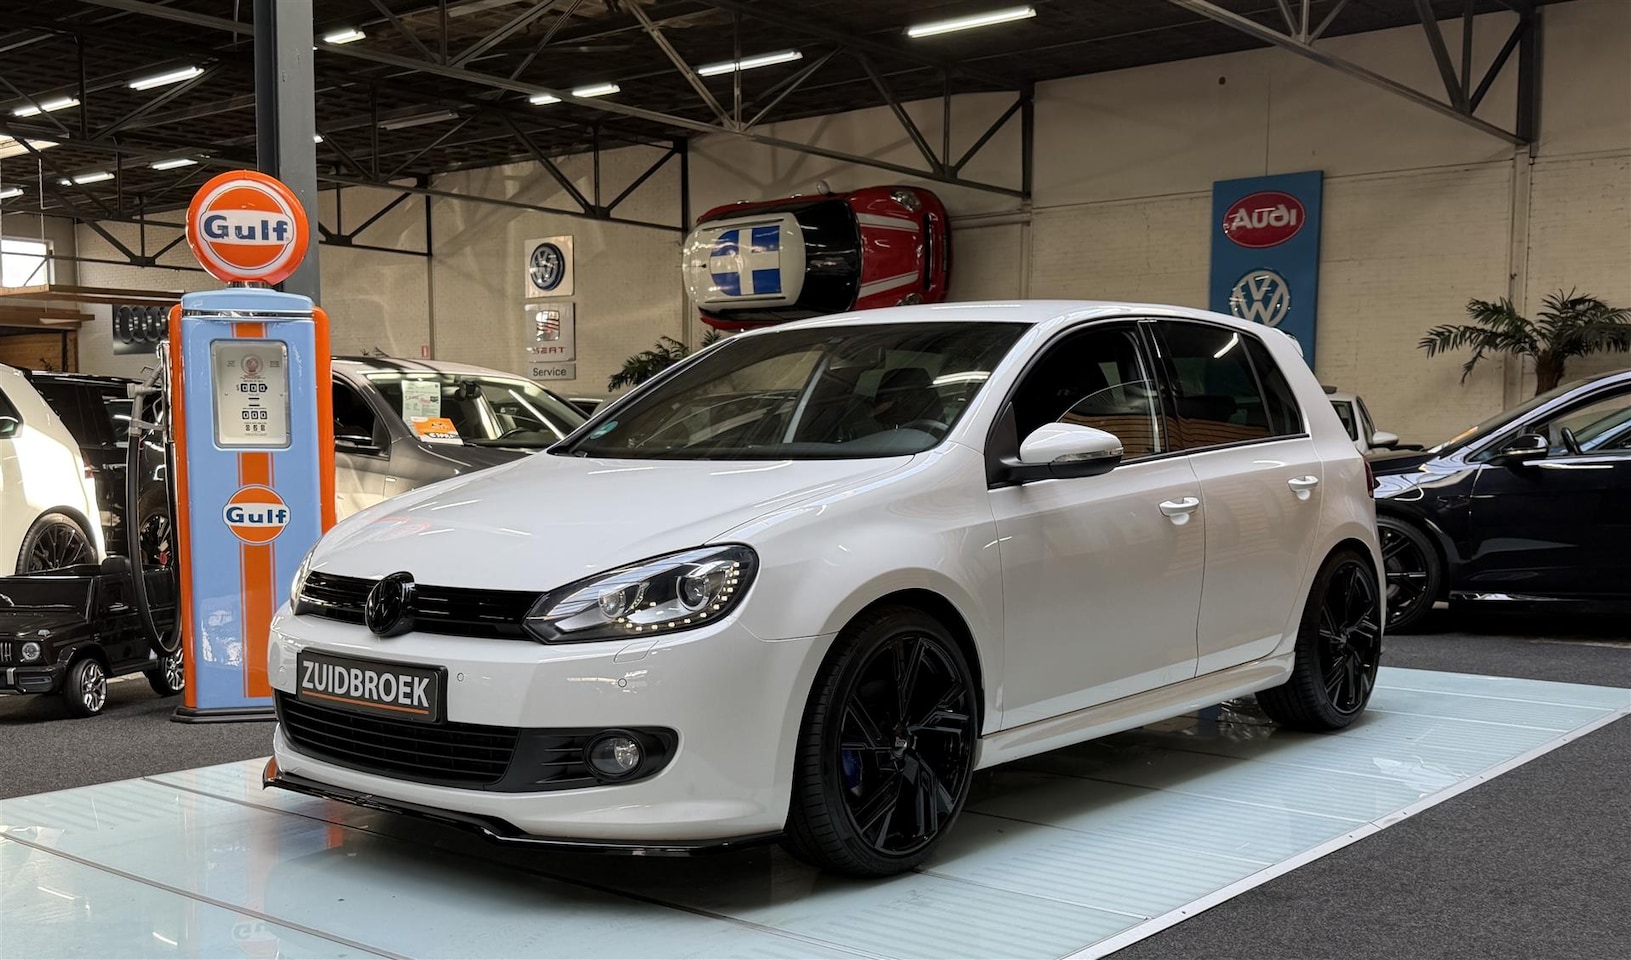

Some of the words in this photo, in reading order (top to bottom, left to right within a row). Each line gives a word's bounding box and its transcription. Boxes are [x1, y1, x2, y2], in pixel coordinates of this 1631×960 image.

[1231, 204, 1297, 230] Audi
[204, 215, 288, 241] Gulf
[532, 346, 565, 354] SEAT
[532, 366, 567, 377] Service
[226, 506, 287, 523] Gulf
[302, 661, 429, 707] ZUIDBROEK
